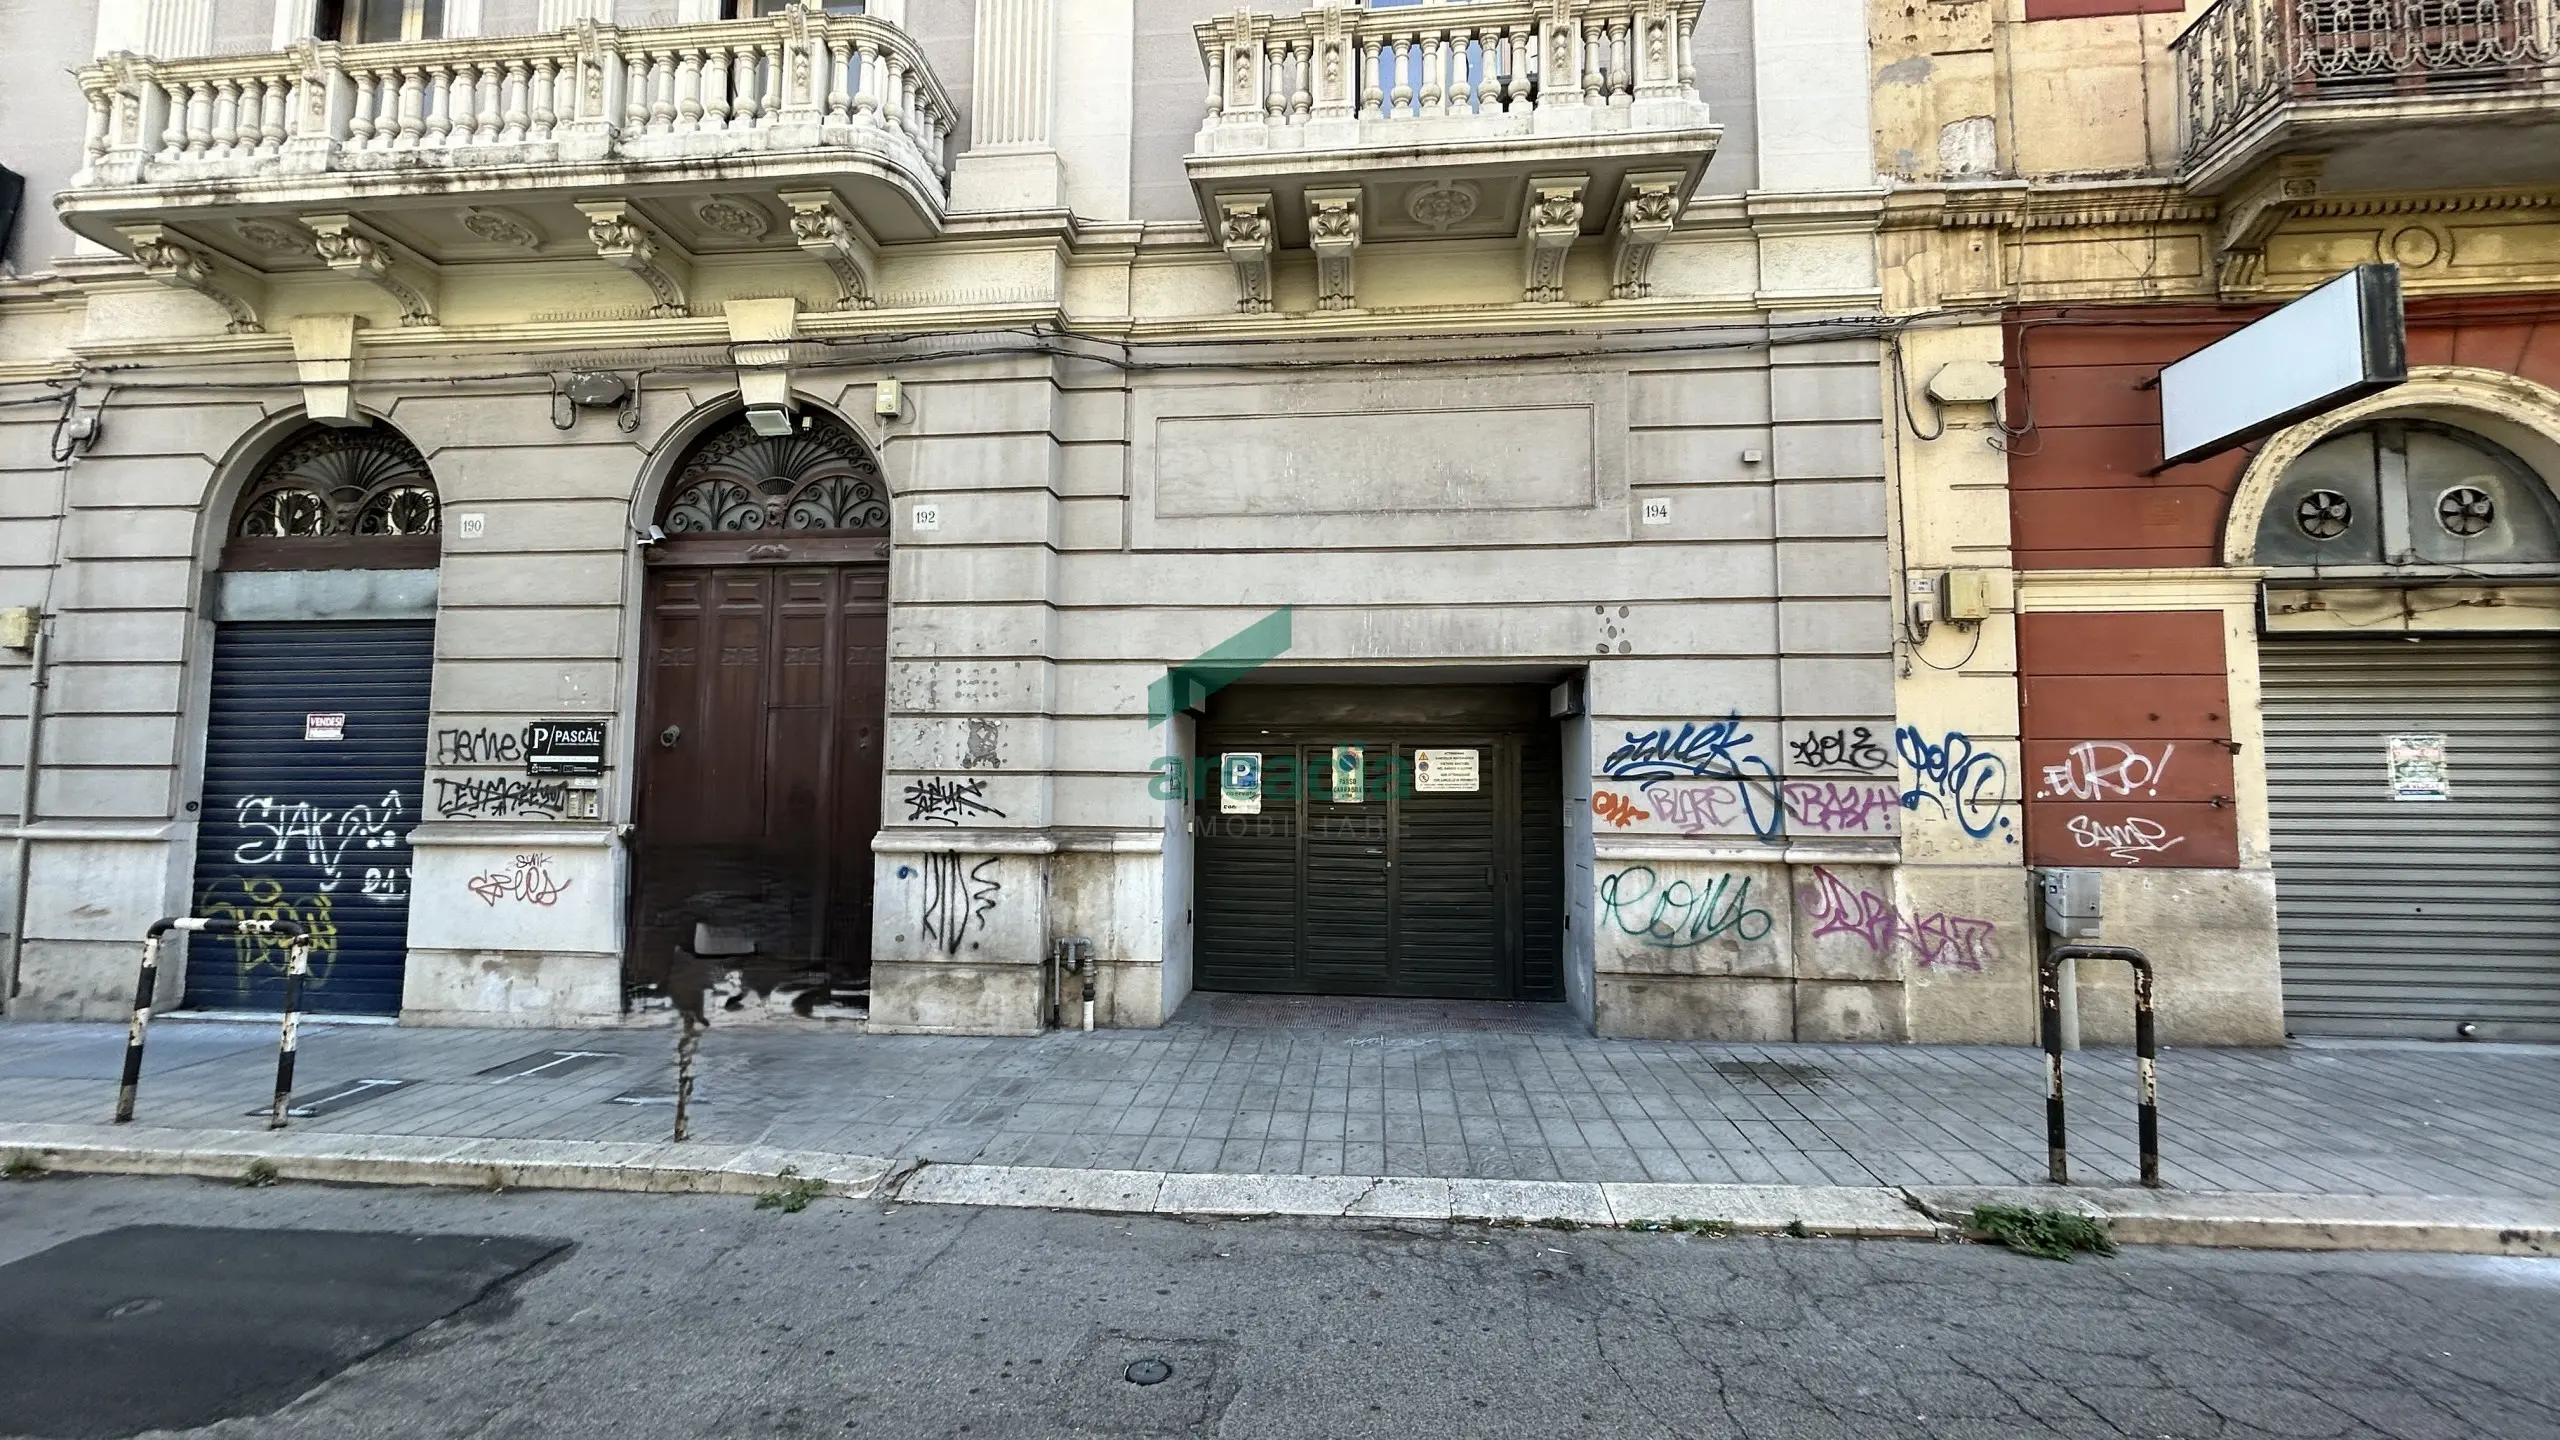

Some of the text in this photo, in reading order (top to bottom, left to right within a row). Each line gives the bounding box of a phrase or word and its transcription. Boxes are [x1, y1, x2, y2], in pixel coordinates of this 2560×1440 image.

[916, 510, 936, 524] 192
[1646, 504, 1668, 518] 194
[463, 520, 482, 532] 190
